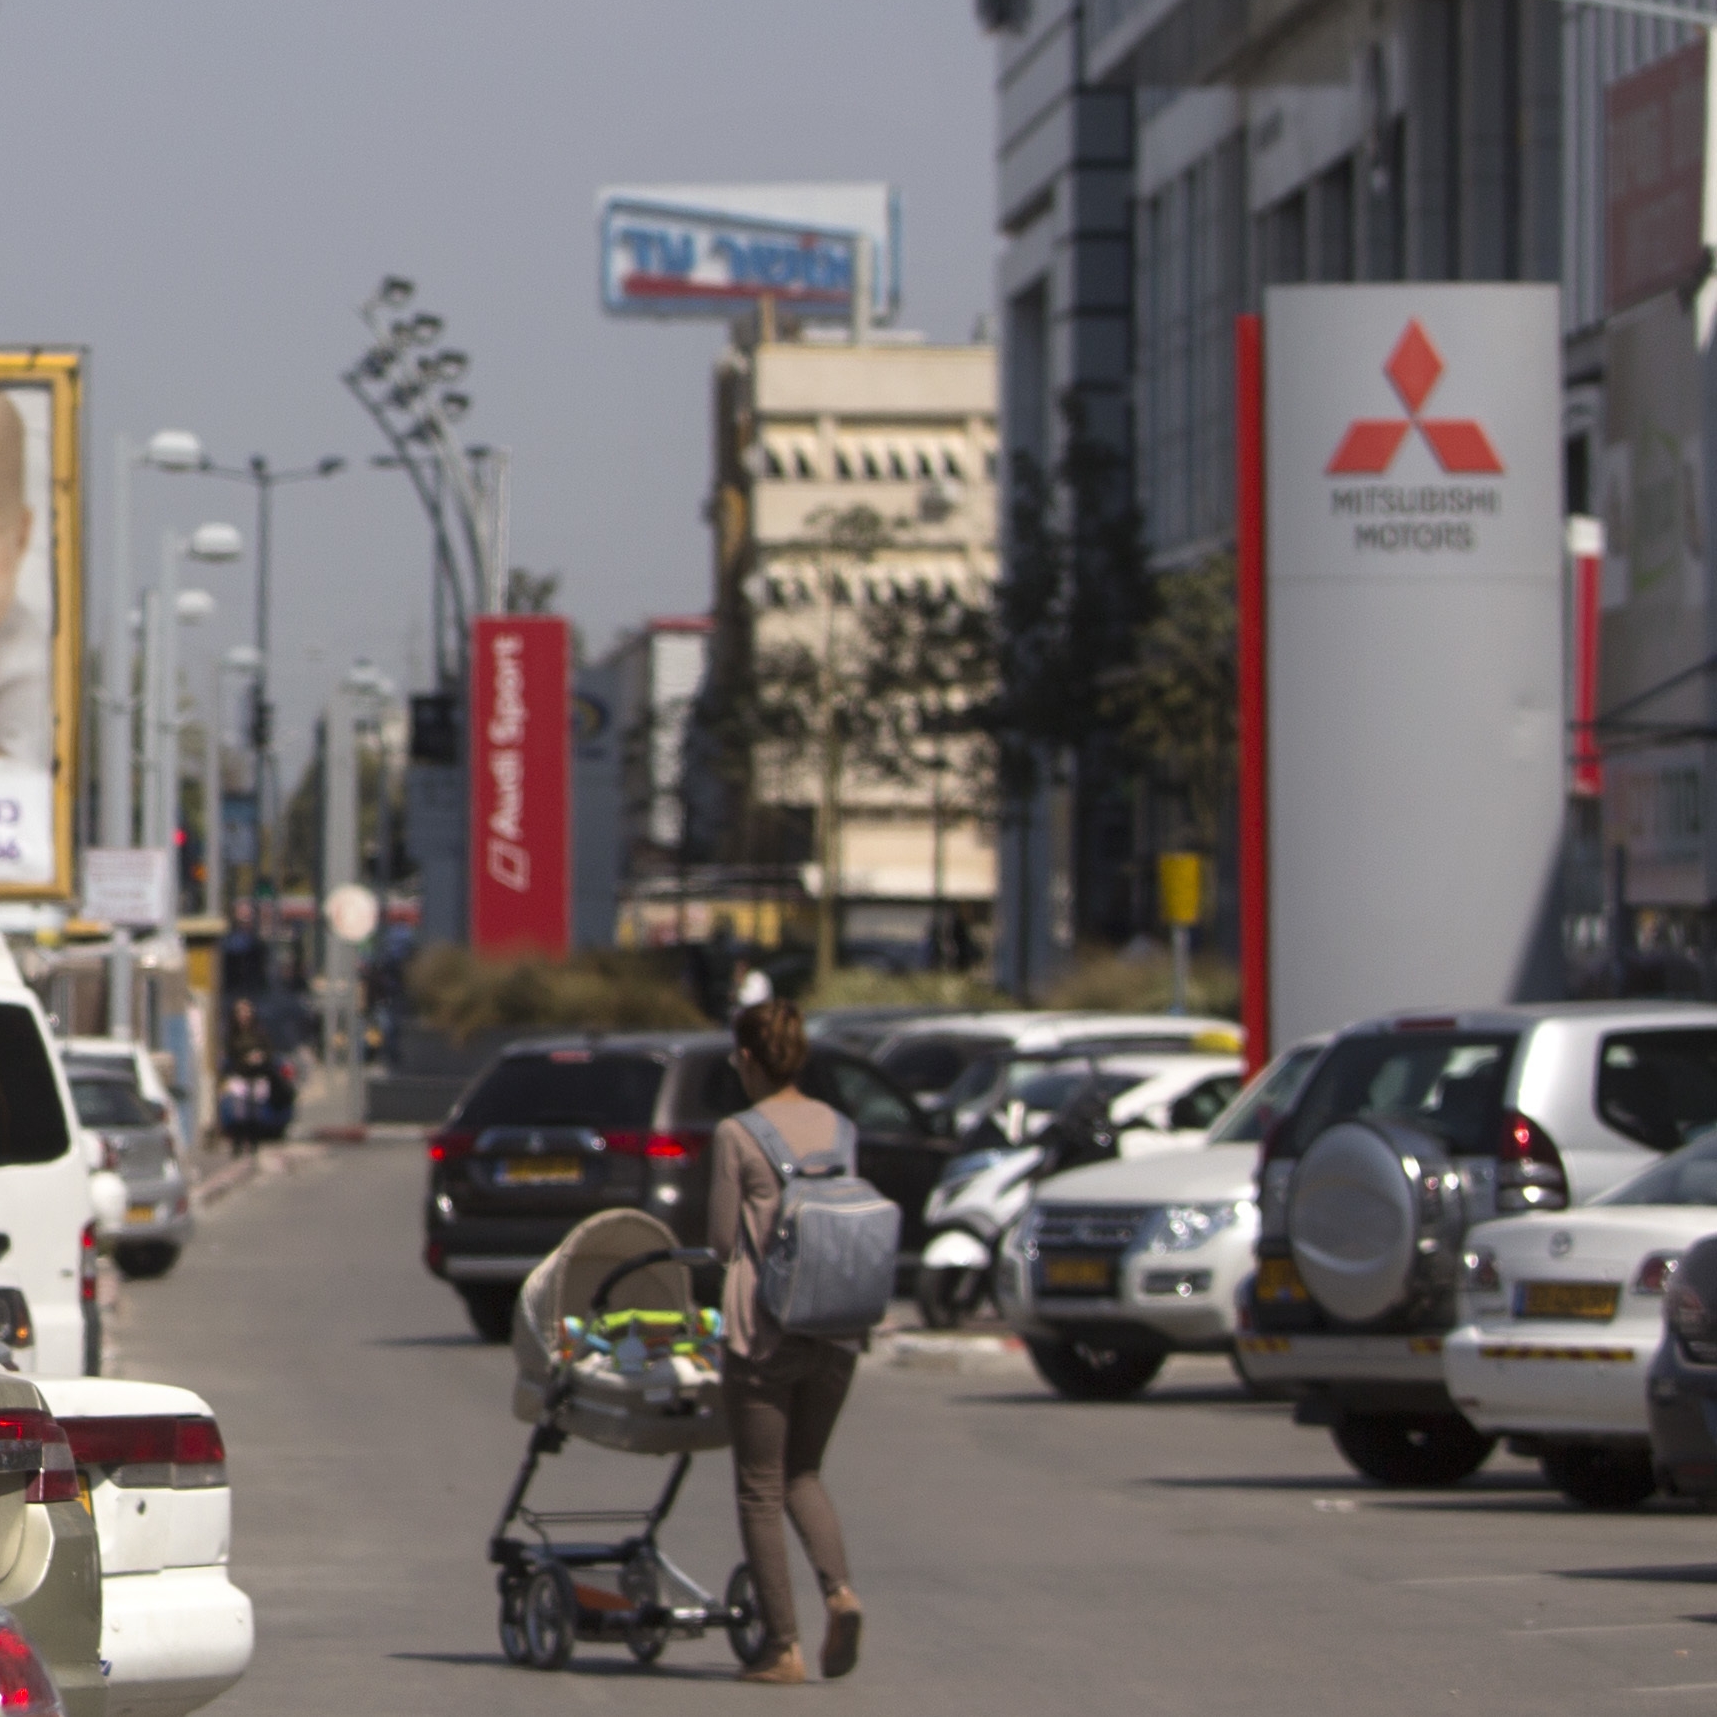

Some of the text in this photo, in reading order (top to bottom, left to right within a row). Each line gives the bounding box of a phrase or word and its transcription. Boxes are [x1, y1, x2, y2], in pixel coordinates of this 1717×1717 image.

[1330, 487, 1500, 516] MITSUBISHI
[1354, 522, 1477, 552] MOTORS
[487, 632, 530, 841] Audi Sport
